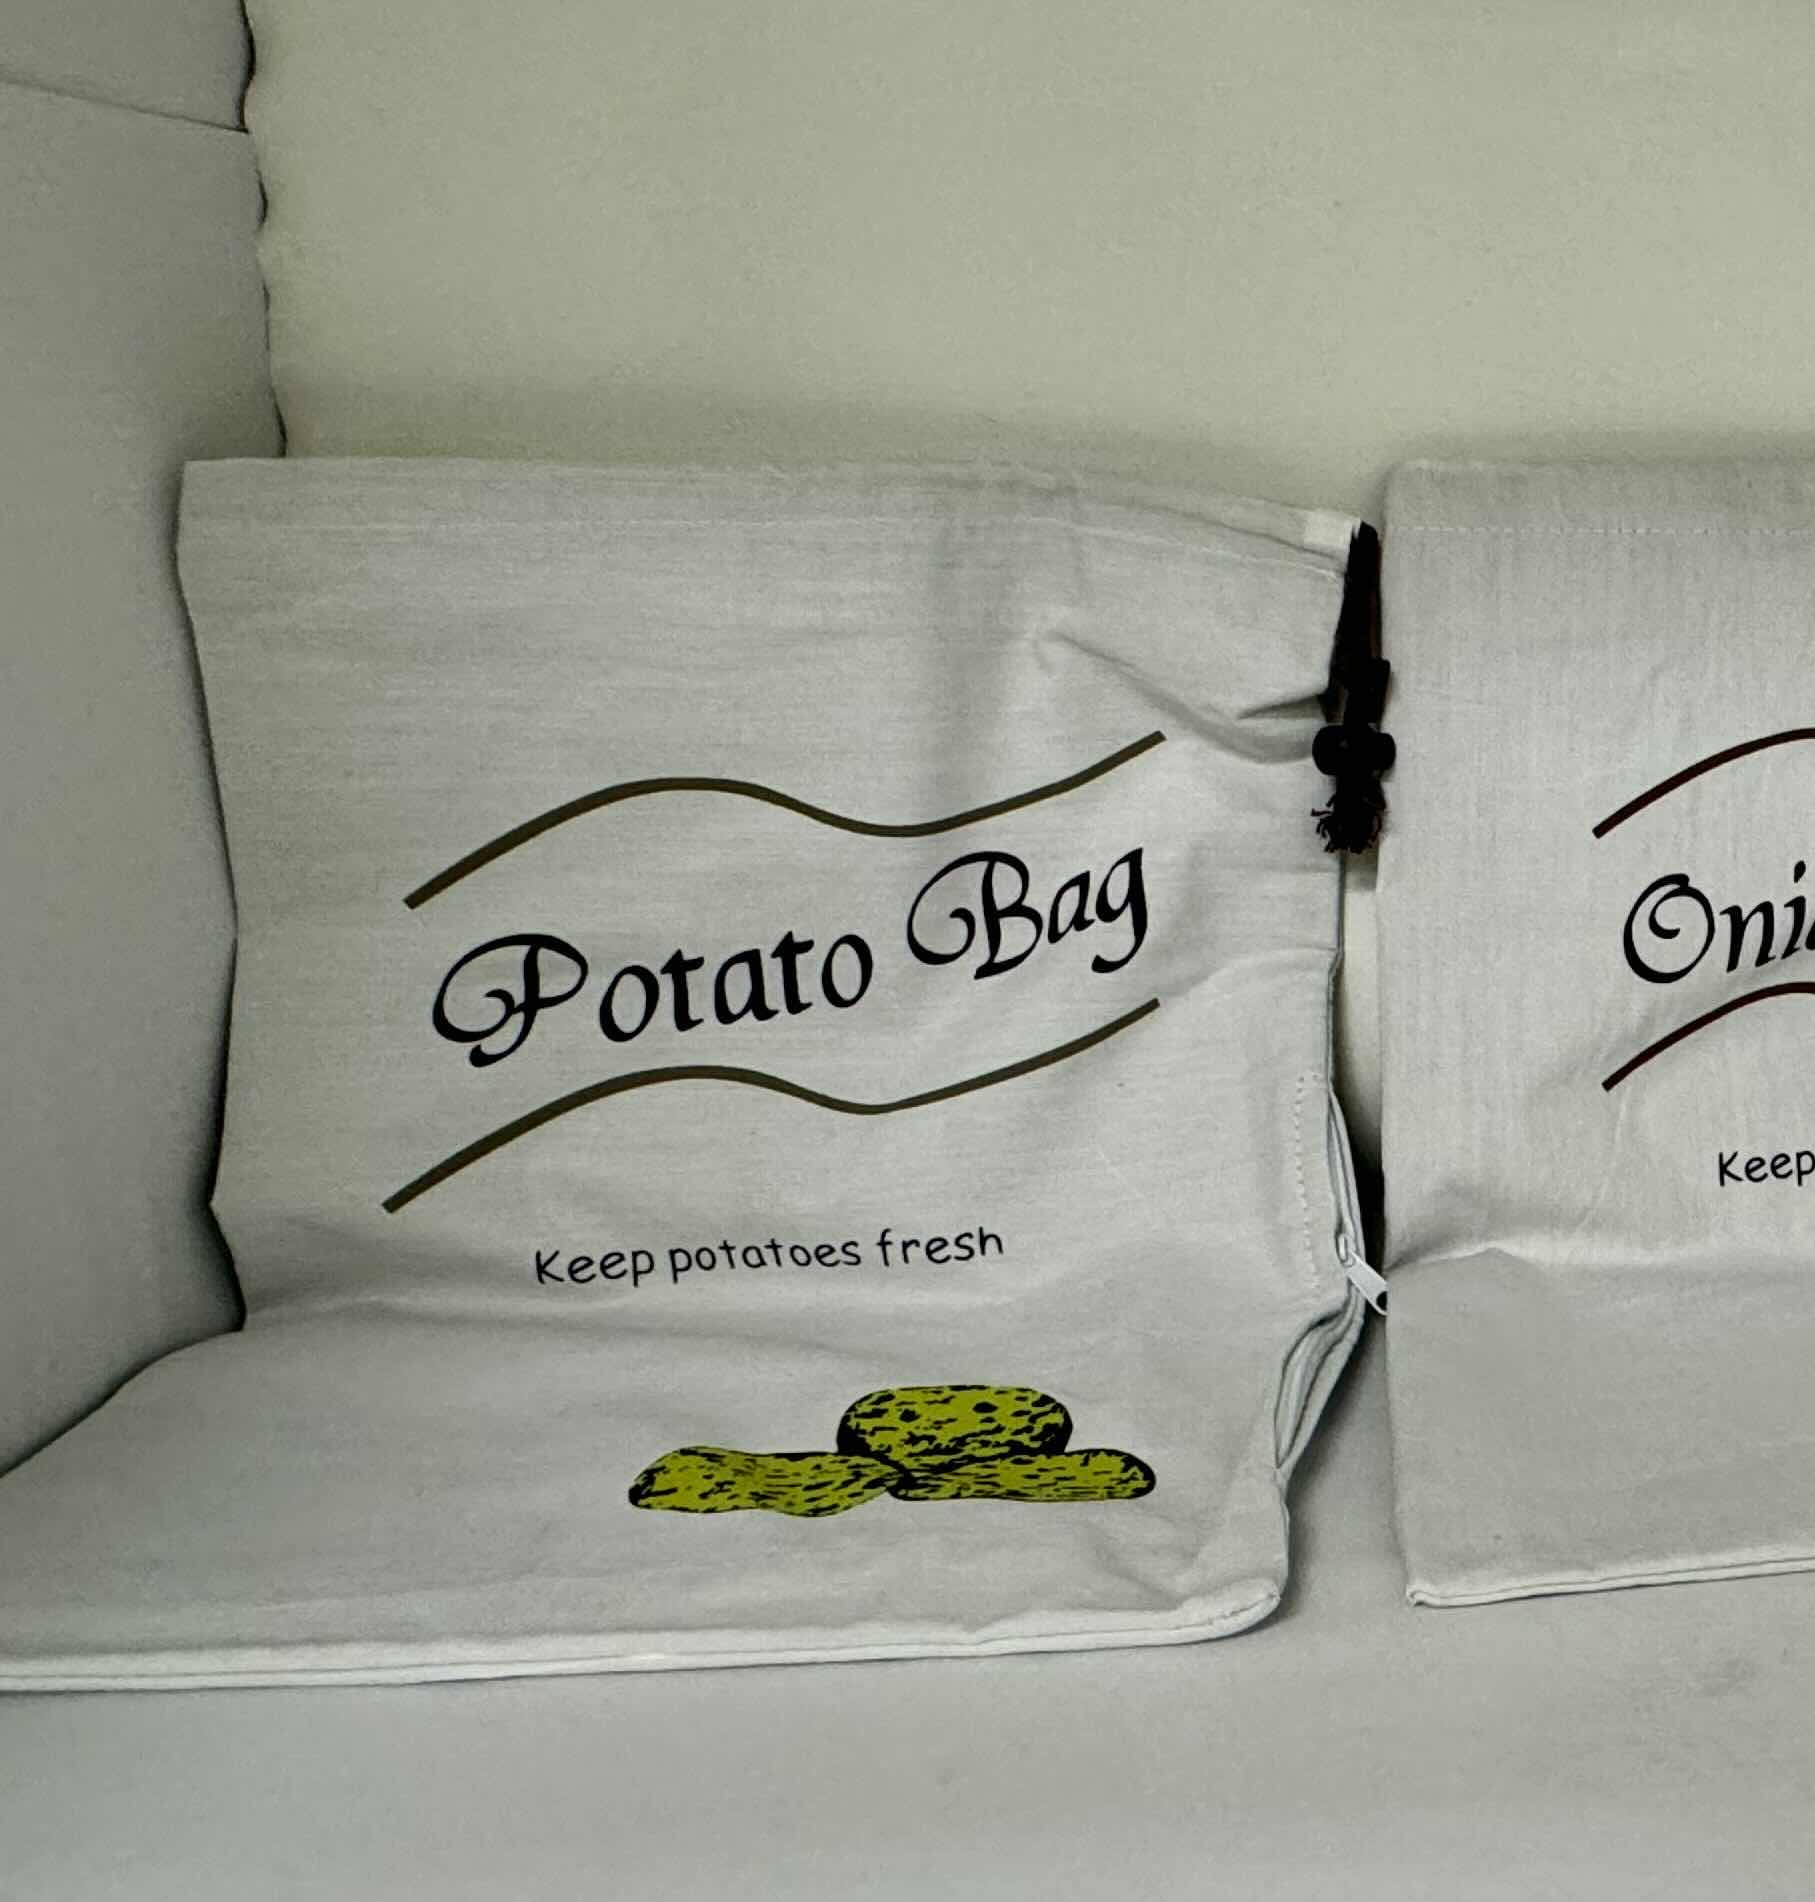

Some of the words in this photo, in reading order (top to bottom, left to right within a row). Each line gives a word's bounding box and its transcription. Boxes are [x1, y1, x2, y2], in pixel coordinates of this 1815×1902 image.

[431, 930, 874, 1069] Potato
[905, 846, 1149, 981] Bag
[534, 1248, 656, 1288] Keep
[667, 1237, 863, 1285] potatoes
[875, 1225, 1004, 1268] fresh
